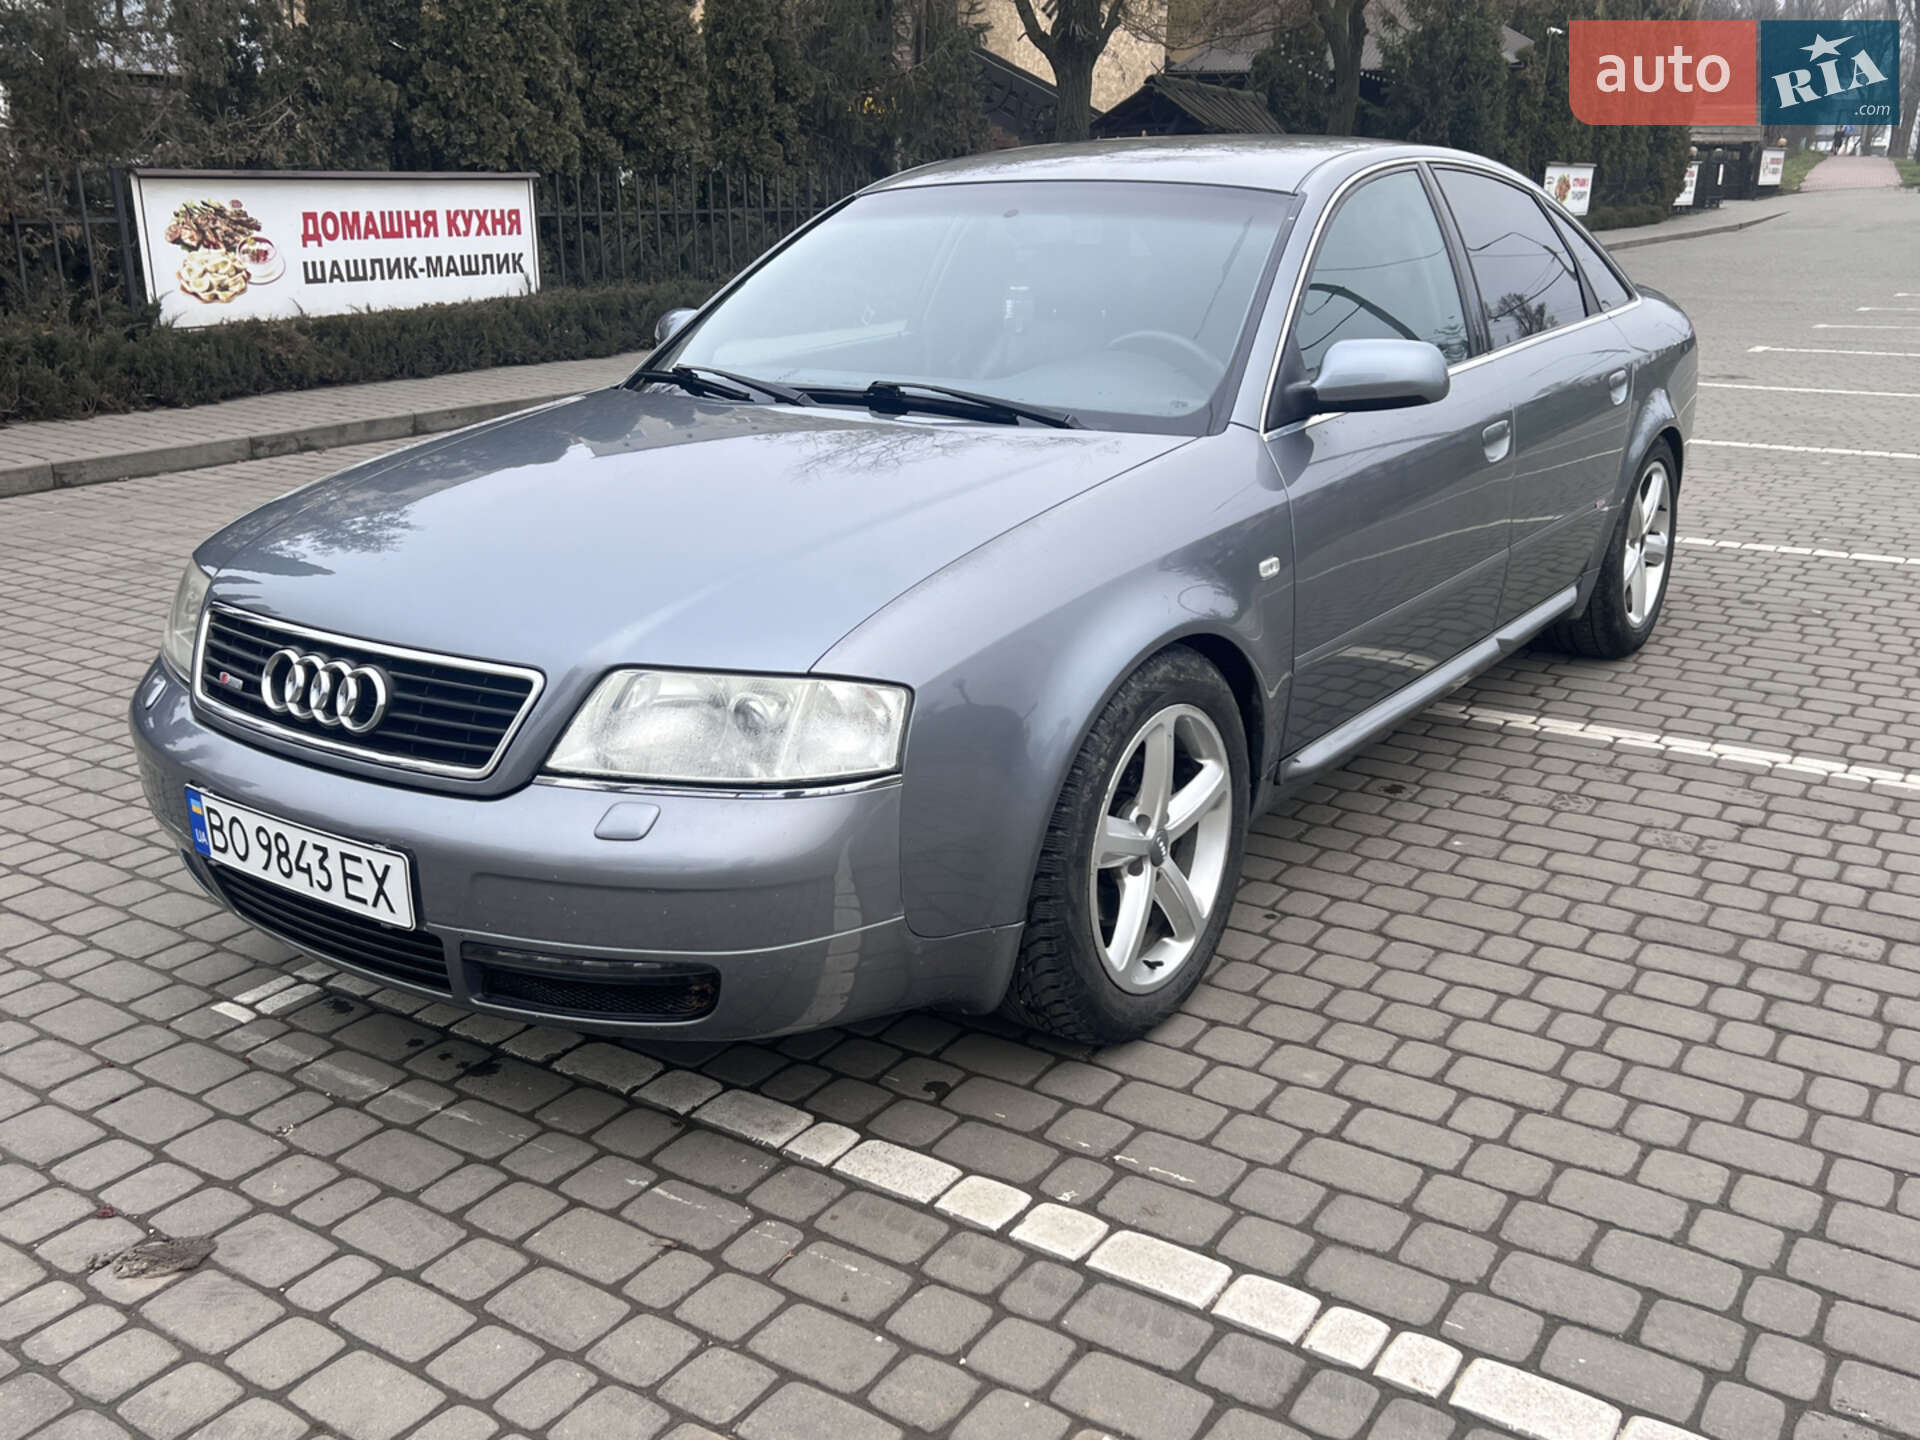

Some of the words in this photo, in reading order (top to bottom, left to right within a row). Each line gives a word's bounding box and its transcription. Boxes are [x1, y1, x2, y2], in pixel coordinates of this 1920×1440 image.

[301, 210, 440, 248] ДОМАШНЯ
[447, 209, 522, 238] КУХНЯ
[302, 252, 526, 285] ШАШЛИК-МАШЛИК
[196, 829, 208, 845] UA
[206, 806, 249, 862] BO
[255, 825, 333, 892] 9843
[339, 851, 396, 914] EX
